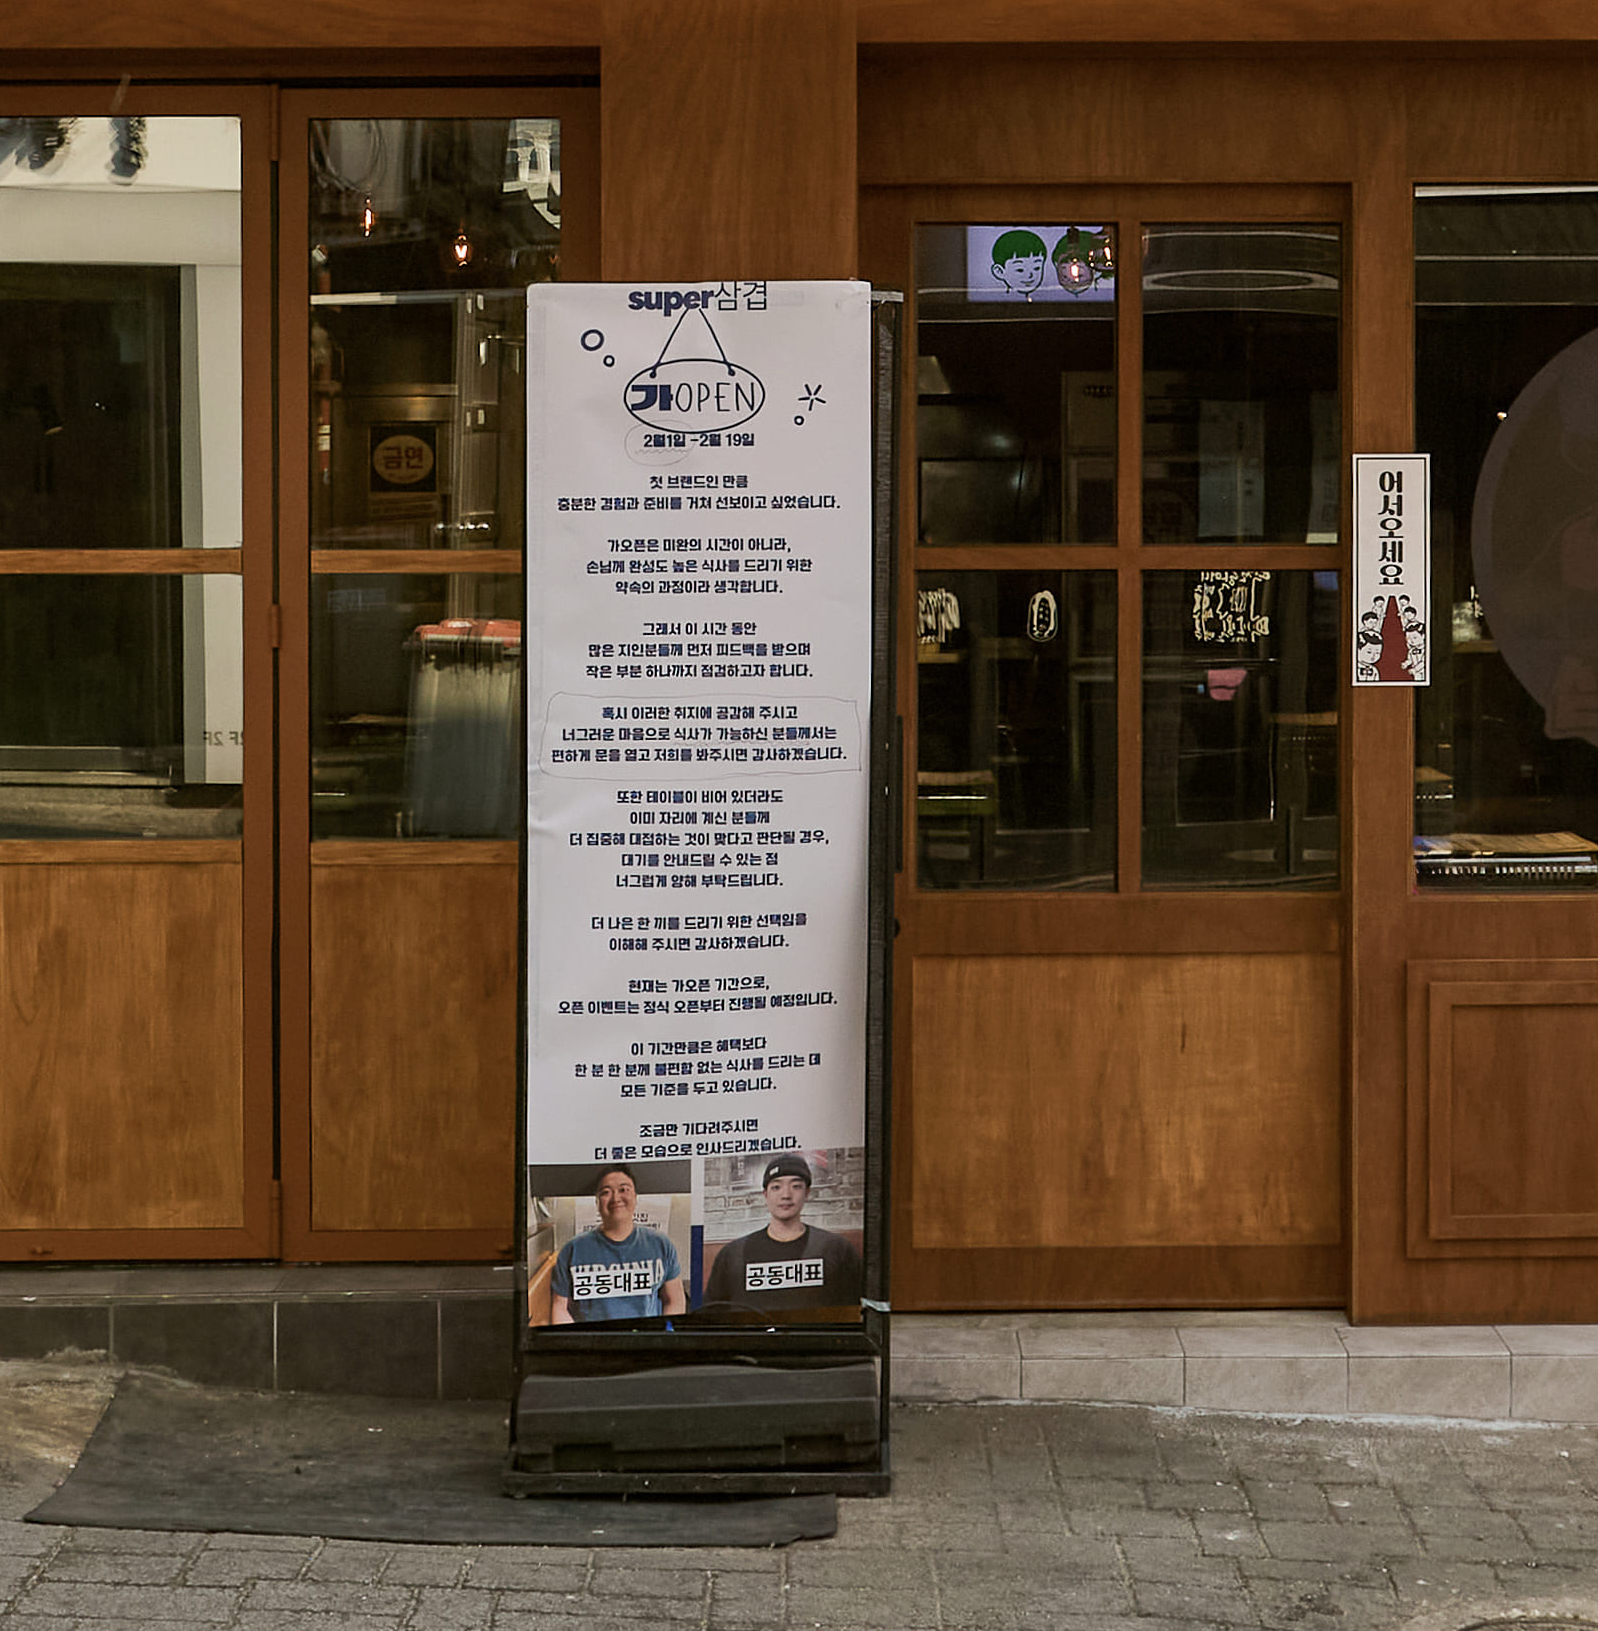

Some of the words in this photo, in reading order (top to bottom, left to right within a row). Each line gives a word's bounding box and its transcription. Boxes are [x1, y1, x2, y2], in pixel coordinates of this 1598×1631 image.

[383, 446, 424, 470] 금연
[649, 475, 664, 490] 첫
[666, 474, 720, 490] 브랜드인
[722, 474, 749, 489] 만큼
[557, 496, 597, 512] 충분한
[599, 496, 640, 512] 경험과
[642, 496, 683, 511] 준비를
[685, 495, 712, 510] 거쳐
[715, 495, 768, 511] 선보이고
[770, 494, 842, 510] 싶었습니다.
[1377, 469, 1407, 587] 어서오세요
[606, 538, 660, 553] 가오픈은
[662, 537, 703, 553] 미완의
[705, 537, 745, 552] 시간이
[747, 537, 792, 554] 아니라,
[586, 559, 626, 575] 손님께
[628, 559, 669, 574] 완성도
[701, 558, 741, 574] 식사를
[743, 558, 783, 573] 드리기
[785, 557, 814, 573] 위한
[615, 580, 655, 596] 약속의
[658, 579, 711, 595] 과정이라
[713, 579, 784, 594] 생각합니다.
[642, 622, 682, 636] 그래서
[684, 621, 698, 636] 이
[700, 621, 729, 636] 시간
[730, 621, 758, 636] 동안
[587, 643, 616, 658] 많은
[617, 642, 684, 658] 지인분들께
[686, 642, 713, 658] 먼저
[715, 642, 769, 657] 피드백을
[771, 642, 811, 657] 받으며
[585, 664, 613, 679] 작은
[615, 664, 643, 679] 부분
[645, 663, 698, 678] 하나까지
[700, 663, 767, 679] 점검하고자
[768, 663, 814, 678] 합니다.
[601, 706, 628, 721] 혹시
[631, 705, 671, 721] 이러한
[673, 705, 713, 720] 취지에
[715, 705, 756, 721] 공감해
[758, 705, 799, 721] 주시고
[562, 727, 616, 742] 너그러운
[618, 726, 671, 742] 마음으로
[673, 726, 713, 742] 식사가
[716, 726, 769, 742] 가능하신
[772, 725, 838, 741] 분들께서는
[551, 748, 592, 764] 편하게
[594, 748, 622, 763] 문을
[653, 747, 693, 763] 저희를
[751, 746, 848, 762] 감사하겠습니다.
[616, 789, 644, 805] 또한
[645, 789, 698, 805] 테이블이
[701, 789, 728, 804] 비어
[730, 789, 785, 805] 있더라도
[629, 810, 656, 825] 이미
[658, 810, 698, 826] 자리에
[700, 810, 728, 826] 계신
[731, 810, 771, 826] 분들께
[569, 832, 583, 847] 더
[586, 832, 626, 847] 집중해
[628, 832, 681, 847] 대접하는
[683, 832, 710, 847] 것이
[713, 831, 754, 847] 맞다고
[756, 830, 796, 846] 판단될
[798, 829, 830, 846] 경우,
[621, 853, 660, 868] 대기를
[663, 852, 716, 868] 안내드릴
[719, 852, 733, 868] 수
[735, 852, 763, 867] 있는
[765, 851, 779, 866] 점
[615, 874, 668, 889] 너그럽게
[700, 872, 784, 889] 부탁드립니다.
[591, 916, 605, 930] 더
[607, 916, 635, 931] 나은
[636, 916, 651, 931] 한
[683, 915, 723, 930] 드리기
[726, 914, 754, 929] 위한
[755, 912, 808, 929] 선택임을
[608, 937, 648, 952] 이해해
[651, 937, 692, 952] 주시면
[694, 933, 790, 951] 감사하겠습니다.
[627, 979, 668, 994] 현재는
[670, 978, 712, 993] 가오픈
[714, 975, 770, 995] 기간으로,
[630, 1042, 644, 1057] 이
[647, 1040, 714, 1056] 기간만큼은
[619, 1083, 647, 1098] 모든
[649, 1082, 690, 1097] 기준을
[692, 1080, 720, 1096] 두고
[721, 1076, 778, 1094] 있습니다.
[638, 1123, 679, 1139] 조금만
[681, 1118, 759, 1136] 기다려주시면
[746, 1261, 824, 1287] 공동대표
[574, 1272, 651, 1297] 공동대표
